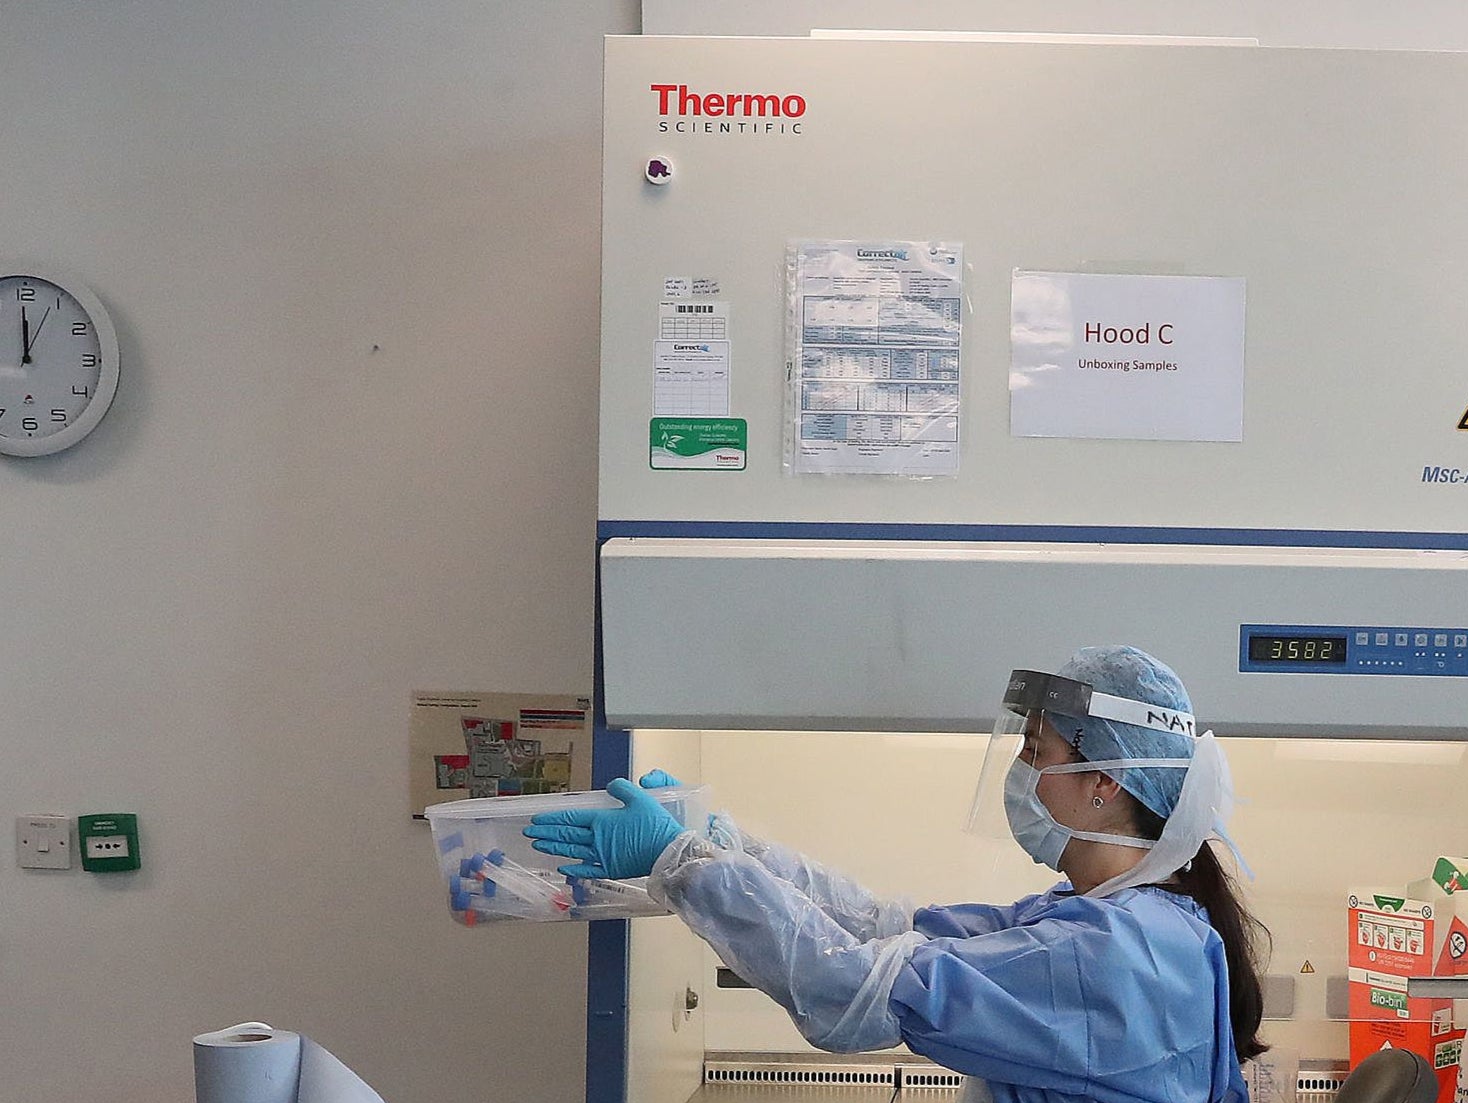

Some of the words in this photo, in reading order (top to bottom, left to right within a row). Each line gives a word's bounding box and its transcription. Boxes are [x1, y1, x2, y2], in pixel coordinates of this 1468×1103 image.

[650, 84, 806, 117] Thermo
[658, 121, 802, 134] SCIENTIFIC
[16, 287, 36, 302] 12
[72, 322, 87, 335] 2
[1085, 322, 1150, 343] Hood
[1158, 324, 1174, 344] C
[82, 353, 97, 367] 3
[1078, 359, 1130, 371] Unboxing
[1132, 360, 1178, 372] Samples
[72, 385, 88, 398] 4
[50, 408, 67, 422] 5
[22, 417, 38, 430] 6
[1271, 641, 1332, 659] 3582
[1372, 991, 1403, 1008] Bio-bin
